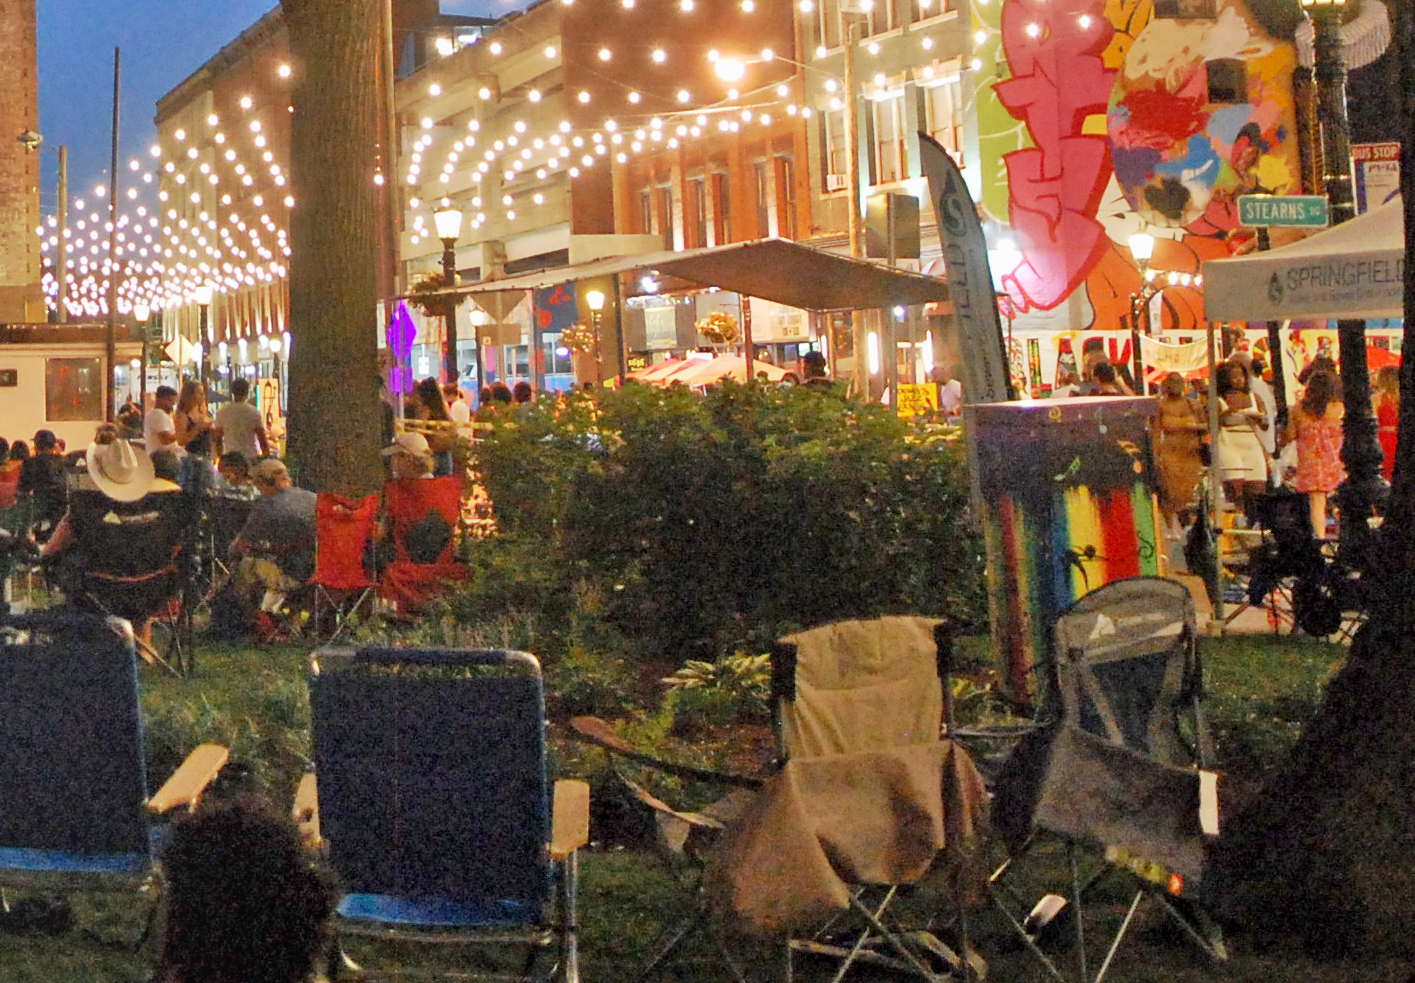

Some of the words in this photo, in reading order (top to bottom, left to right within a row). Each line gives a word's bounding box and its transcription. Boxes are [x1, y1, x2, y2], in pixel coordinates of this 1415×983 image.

[1351, 148, 1372, 160] BUS
[1373, 146, 1398, 159] STOP
[1246, 202, 1305, 219] STEARNS
